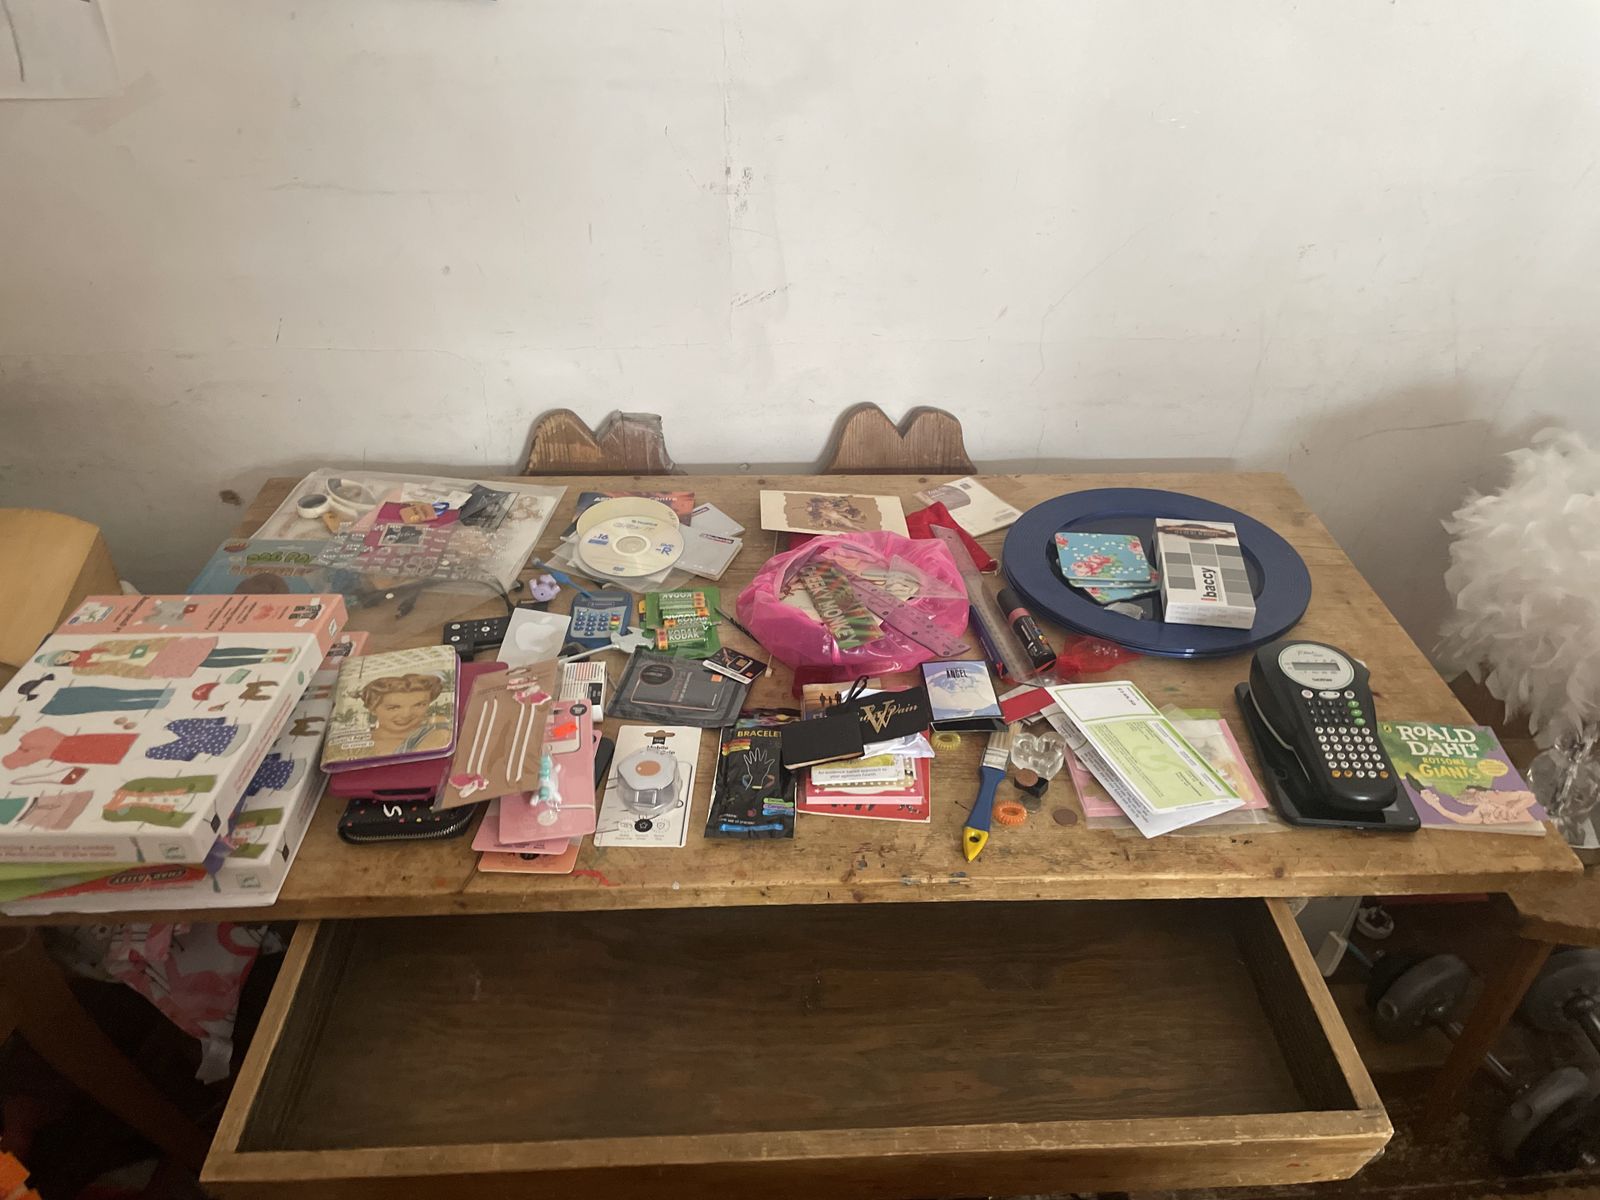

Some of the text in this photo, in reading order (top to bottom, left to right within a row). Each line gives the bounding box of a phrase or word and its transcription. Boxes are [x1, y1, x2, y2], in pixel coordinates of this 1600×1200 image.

[1201, 567, 1217, 598] baccy
[945, 669, 968, 678] ANGEL
[1396, 726, 1476, 743] ROALD
[1406, 741, 1479, 759] DAHL'S
[1418, 763, 1480, 779] GIANTS
